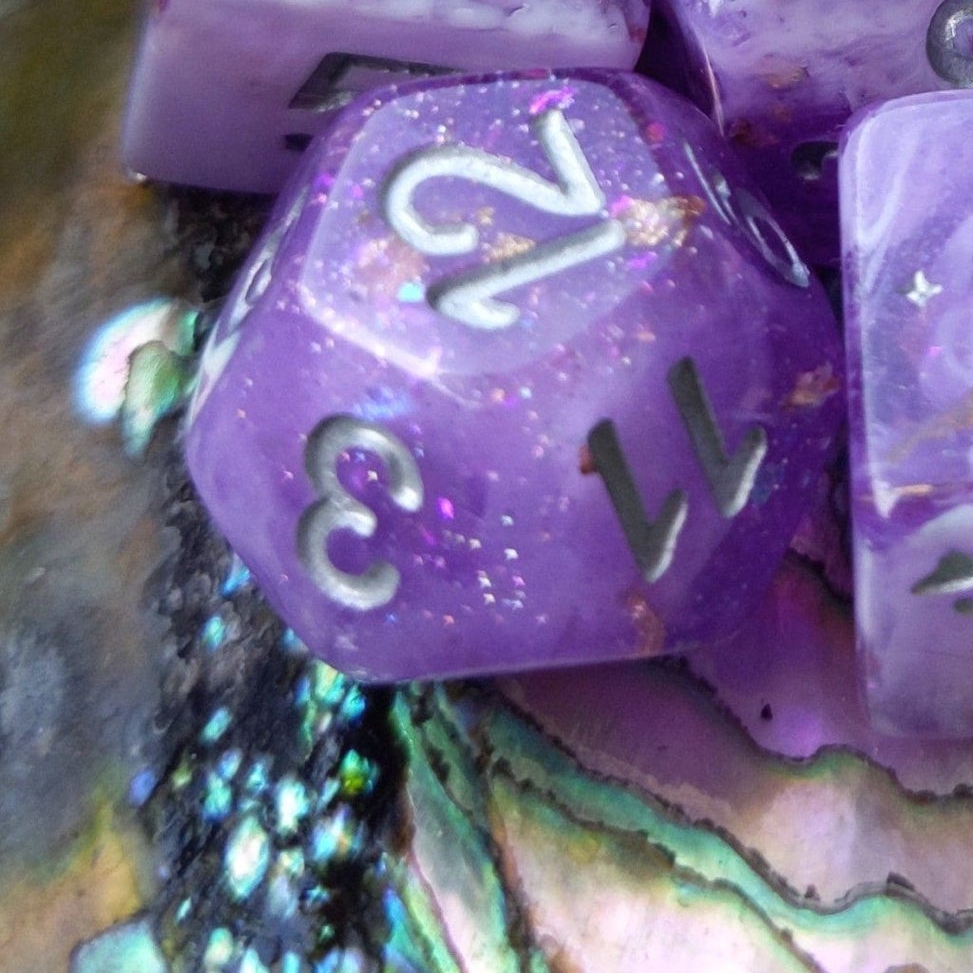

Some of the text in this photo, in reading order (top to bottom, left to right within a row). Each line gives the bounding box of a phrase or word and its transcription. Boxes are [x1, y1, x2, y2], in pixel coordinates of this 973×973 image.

[381, 108, 627, 329] 12
[297, 413, 424, 610] 3
[586, 356, 767, 583] 11
